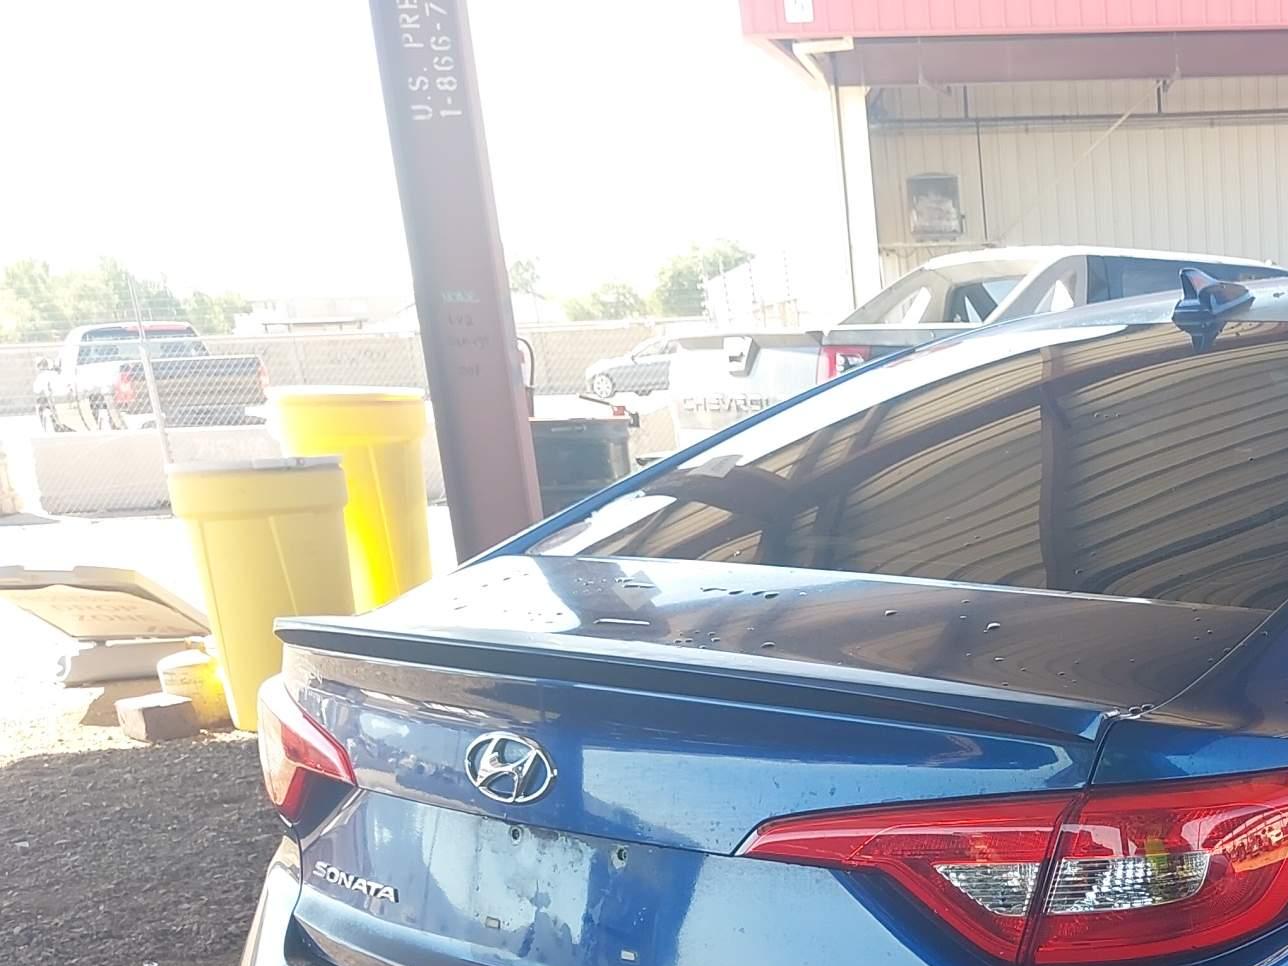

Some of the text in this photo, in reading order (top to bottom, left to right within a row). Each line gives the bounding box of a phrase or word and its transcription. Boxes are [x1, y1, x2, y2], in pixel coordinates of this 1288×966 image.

[425, 2, 462, 117] 1-866-7
[408, 67, 432, 120] U.S.
[312, 861, 399, 903] SONATA
